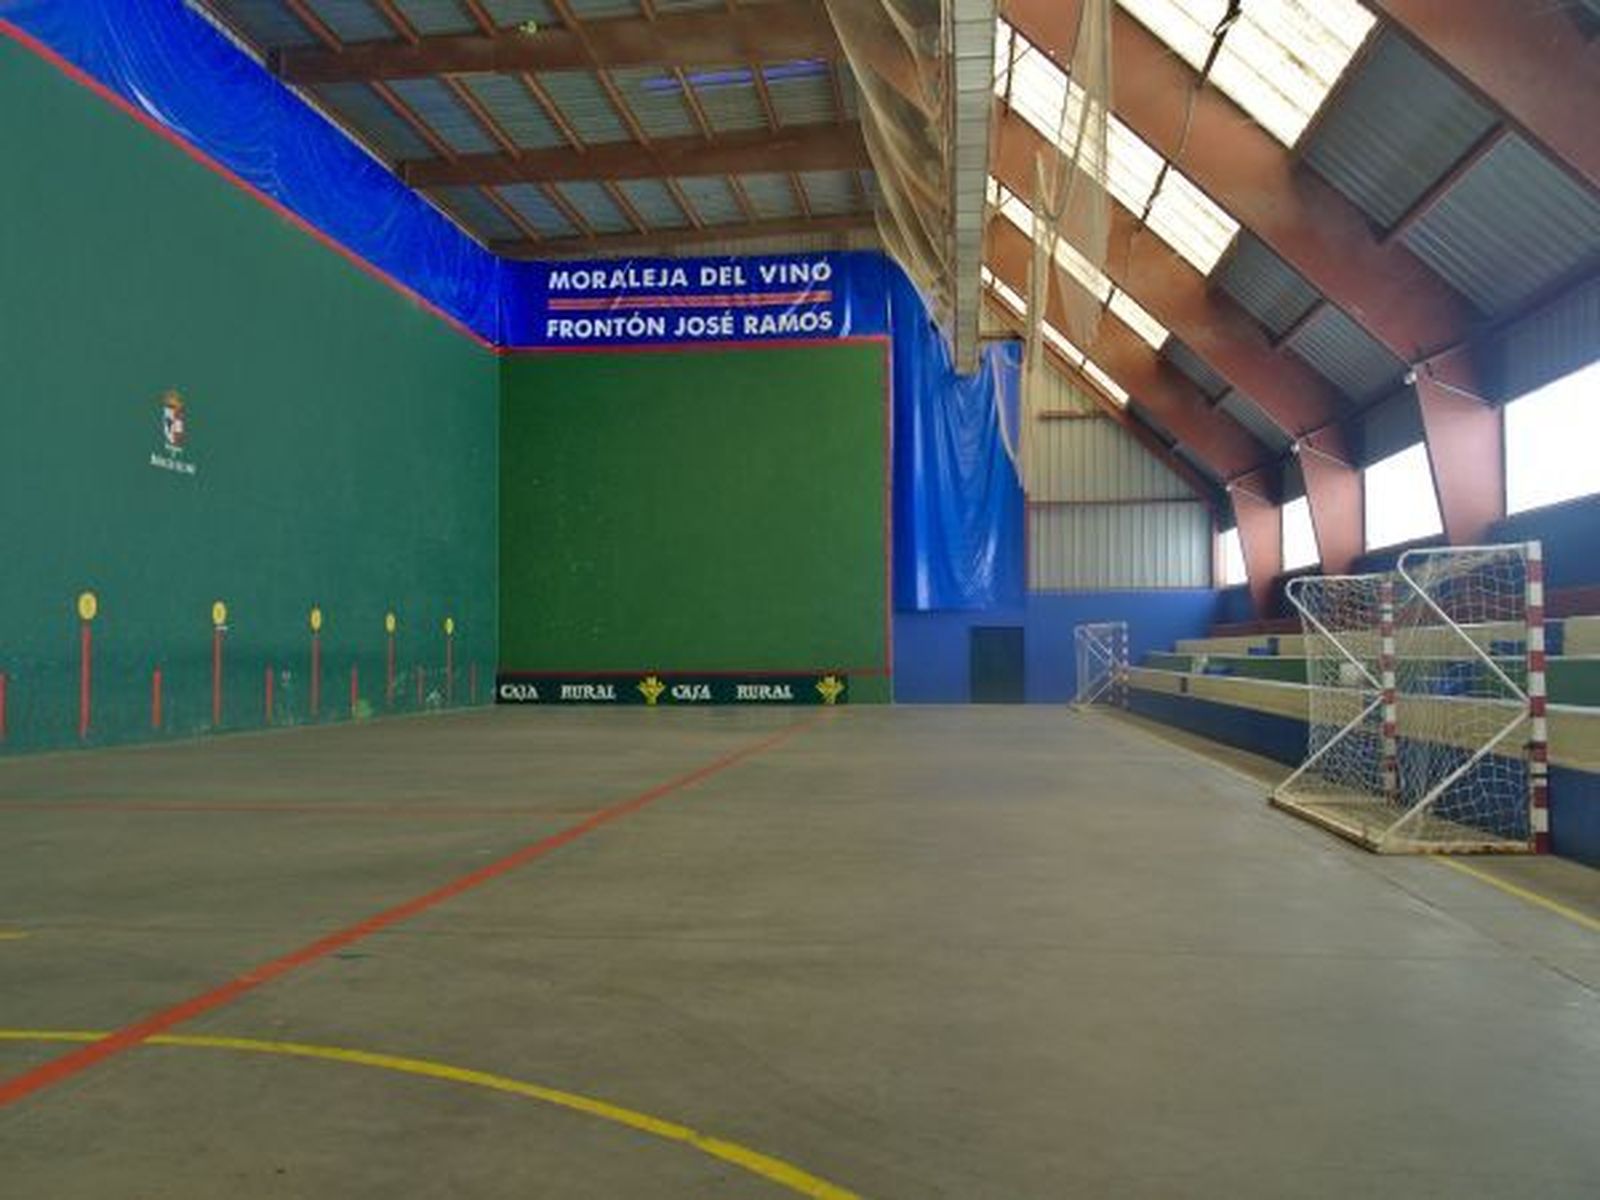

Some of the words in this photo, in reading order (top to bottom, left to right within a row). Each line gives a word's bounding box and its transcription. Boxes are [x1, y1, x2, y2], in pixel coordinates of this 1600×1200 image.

[549, 269, 688, 290] MORALEJA
[701, 267, 745, 286] DEL
[759, 261, 832, 283] VINO
[546, 312, 665, 338] FRONTÓN
[673, 311, 734, 335] JOSÉ
[743, 312, 833, 335] RAMOS
[560, 684, 616, 700] RURAL
[736, 684, 793, 700] RURAL
